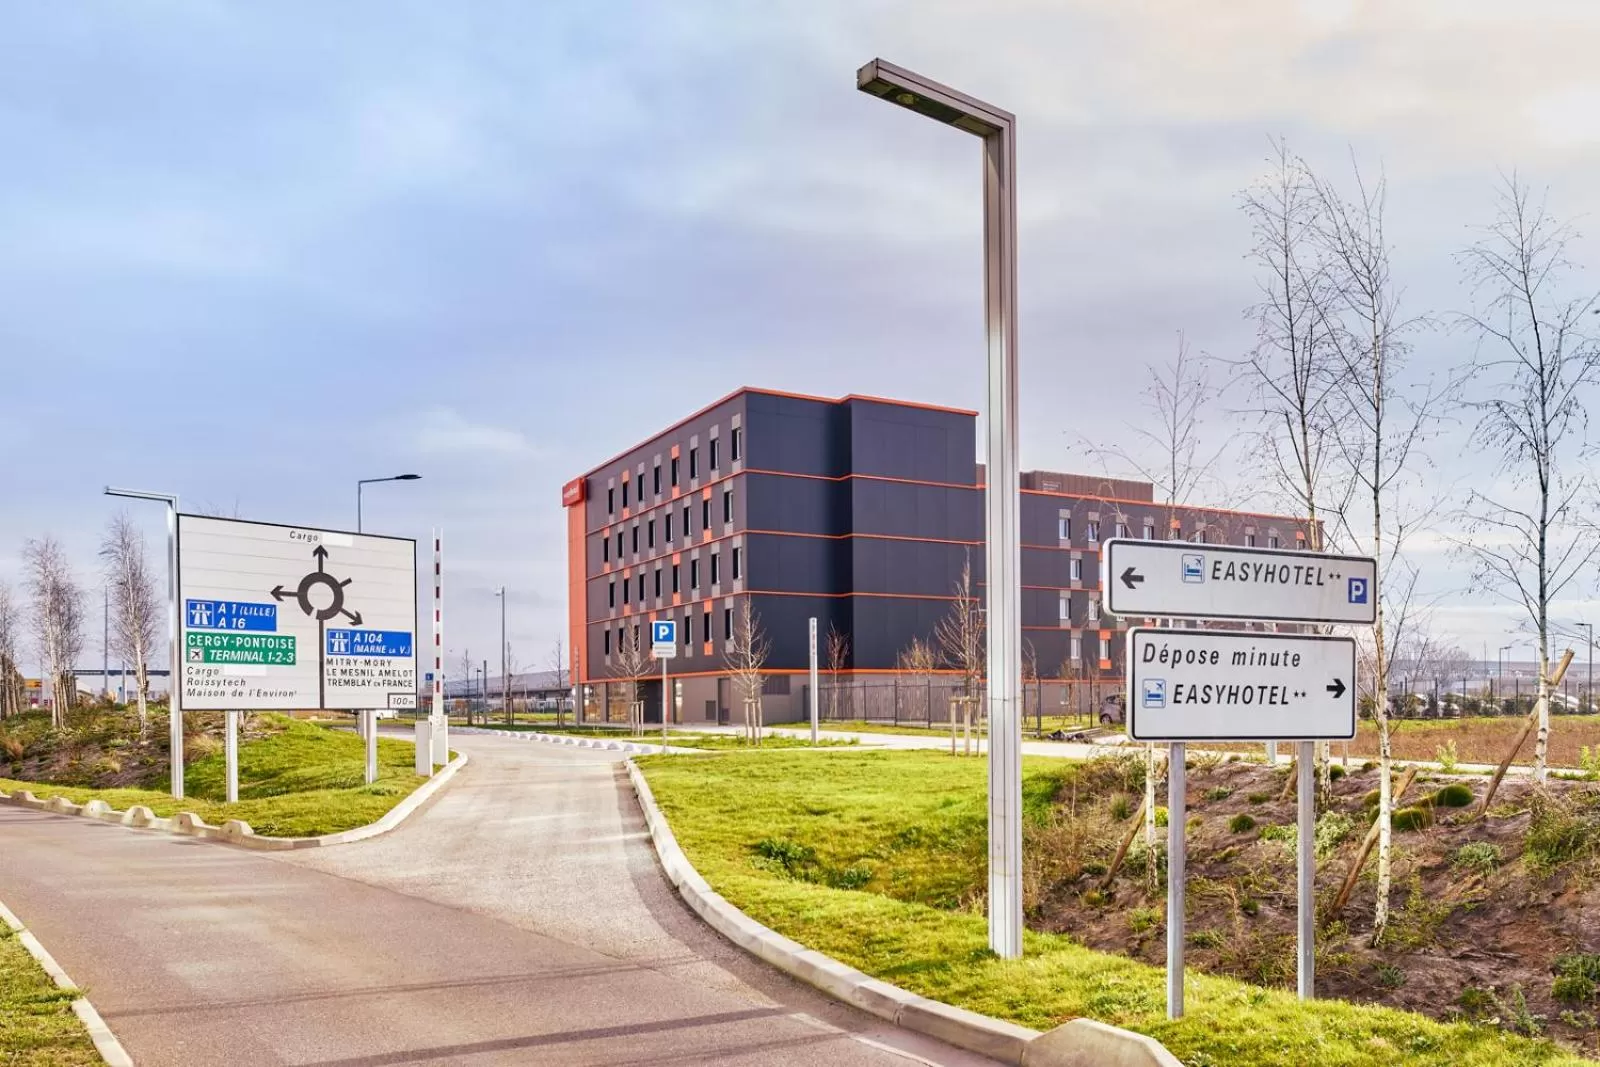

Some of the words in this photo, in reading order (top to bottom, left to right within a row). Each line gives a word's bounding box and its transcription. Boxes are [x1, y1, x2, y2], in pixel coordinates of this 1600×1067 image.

[290, 531, 319, 542] Cargo
[1351, 581, 1364, 602] P
[218, 603, 226, 614] A
[232, 604, 237, 614] 1
[240, 606, 275, 617] (LILLE)
[218, 617, 226, 628] A
[232, 618, 246, 629] 16
[354, 632, 360, 643] A
[364, 633, 383, 643] 104
[659, 625, 669, 639] P
[188, 635, 294, 649] CERGY-PONTOISE
[209, 650, 264, 662] TERMINAL
[267, 652, 294, 663] 1-2-3
[1143, 643, 1220, 669] Dépose
[1232, 646, 1301, 668] minute
[327, 658, 392, 666] MITRY-MORY
[187, 666, 219, 677] Cargo
[341, 669, 375, 677] MESNIL
[378, 669, 413, 677] AMELOT
[187, 677, 246, 688] Roissytech
[328, 679, 372, 687] TREMBLAY
[186, 688, 226, 697] Maison
[232, 689, 243, 697] de
